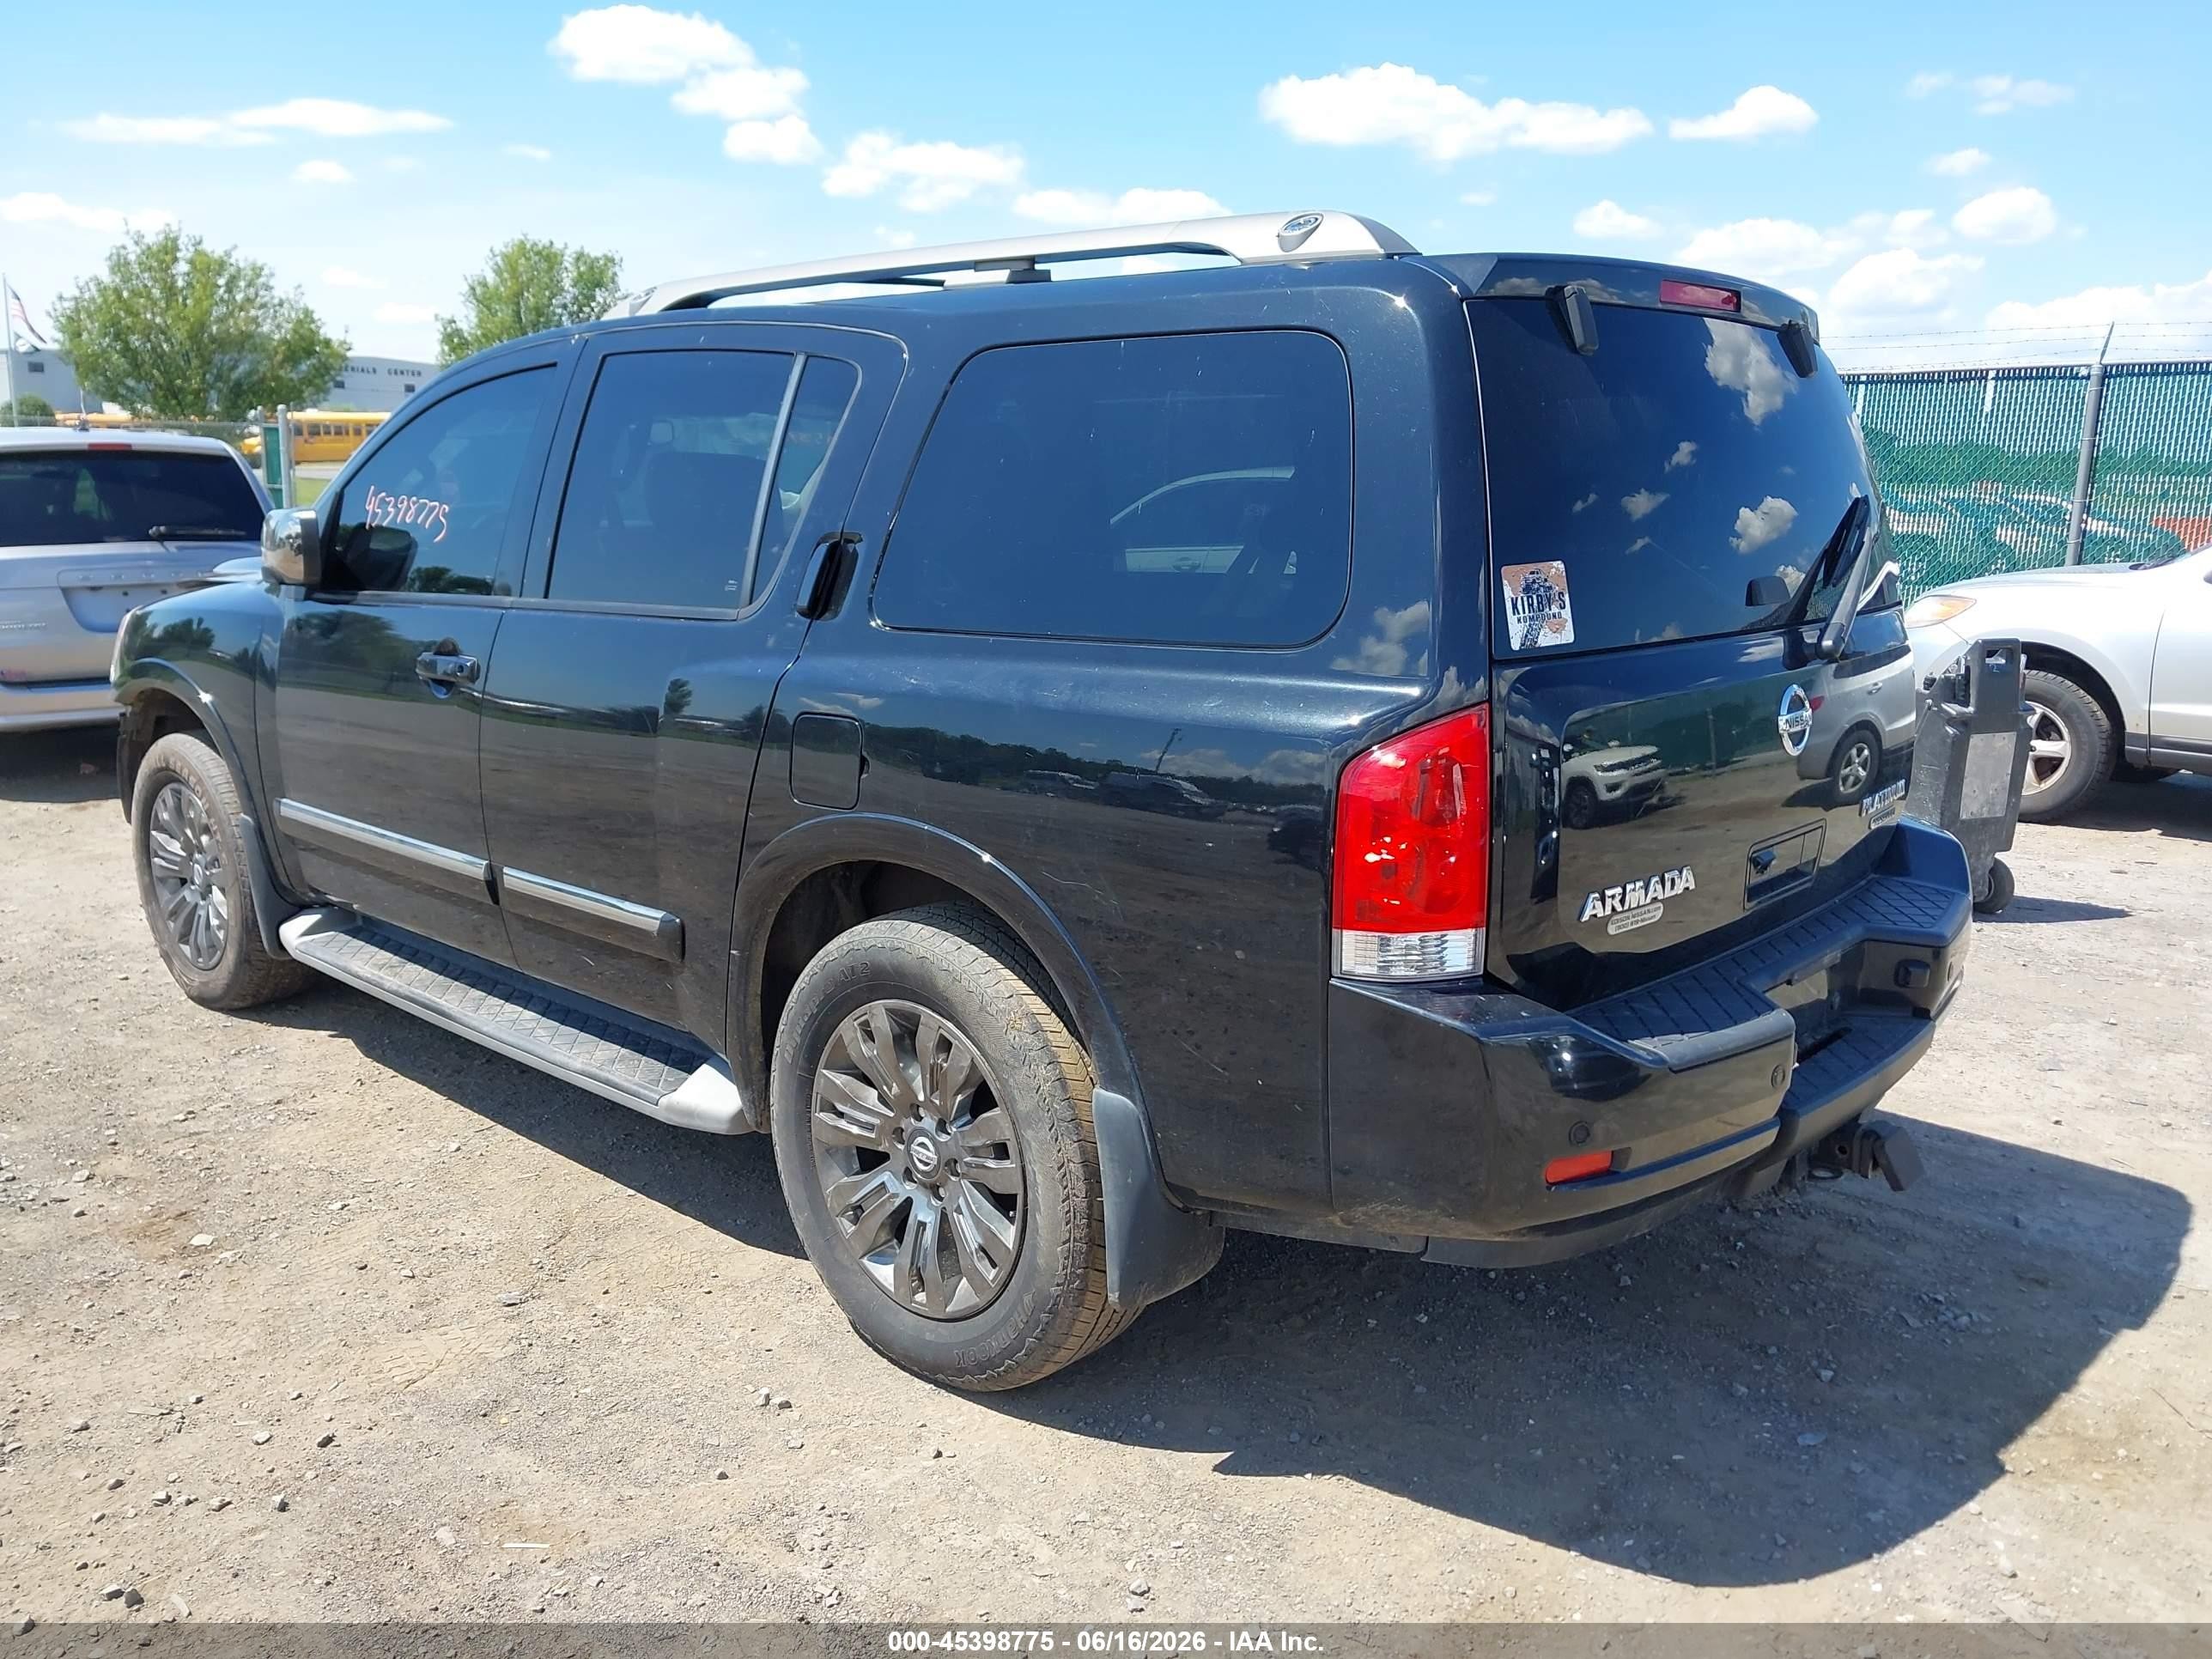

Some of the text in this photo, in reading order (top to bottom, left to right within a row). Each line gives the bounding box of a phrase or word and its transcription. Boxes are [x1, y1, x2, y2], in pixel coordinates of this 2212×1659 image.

[340, 363, 422, 377] ERIALS CENTER
[365, 485, 449, 543] 45398775
[1510, 592, 1566, 617] KIRBY'S
[1516, 611, 1563, 625] KOMPOUND
[1785, 713, 1812, 730] NISSAN
[1861, 778, 1906, 817] PLATINUM
[1579, 865, 1696, 923] ARMADA
